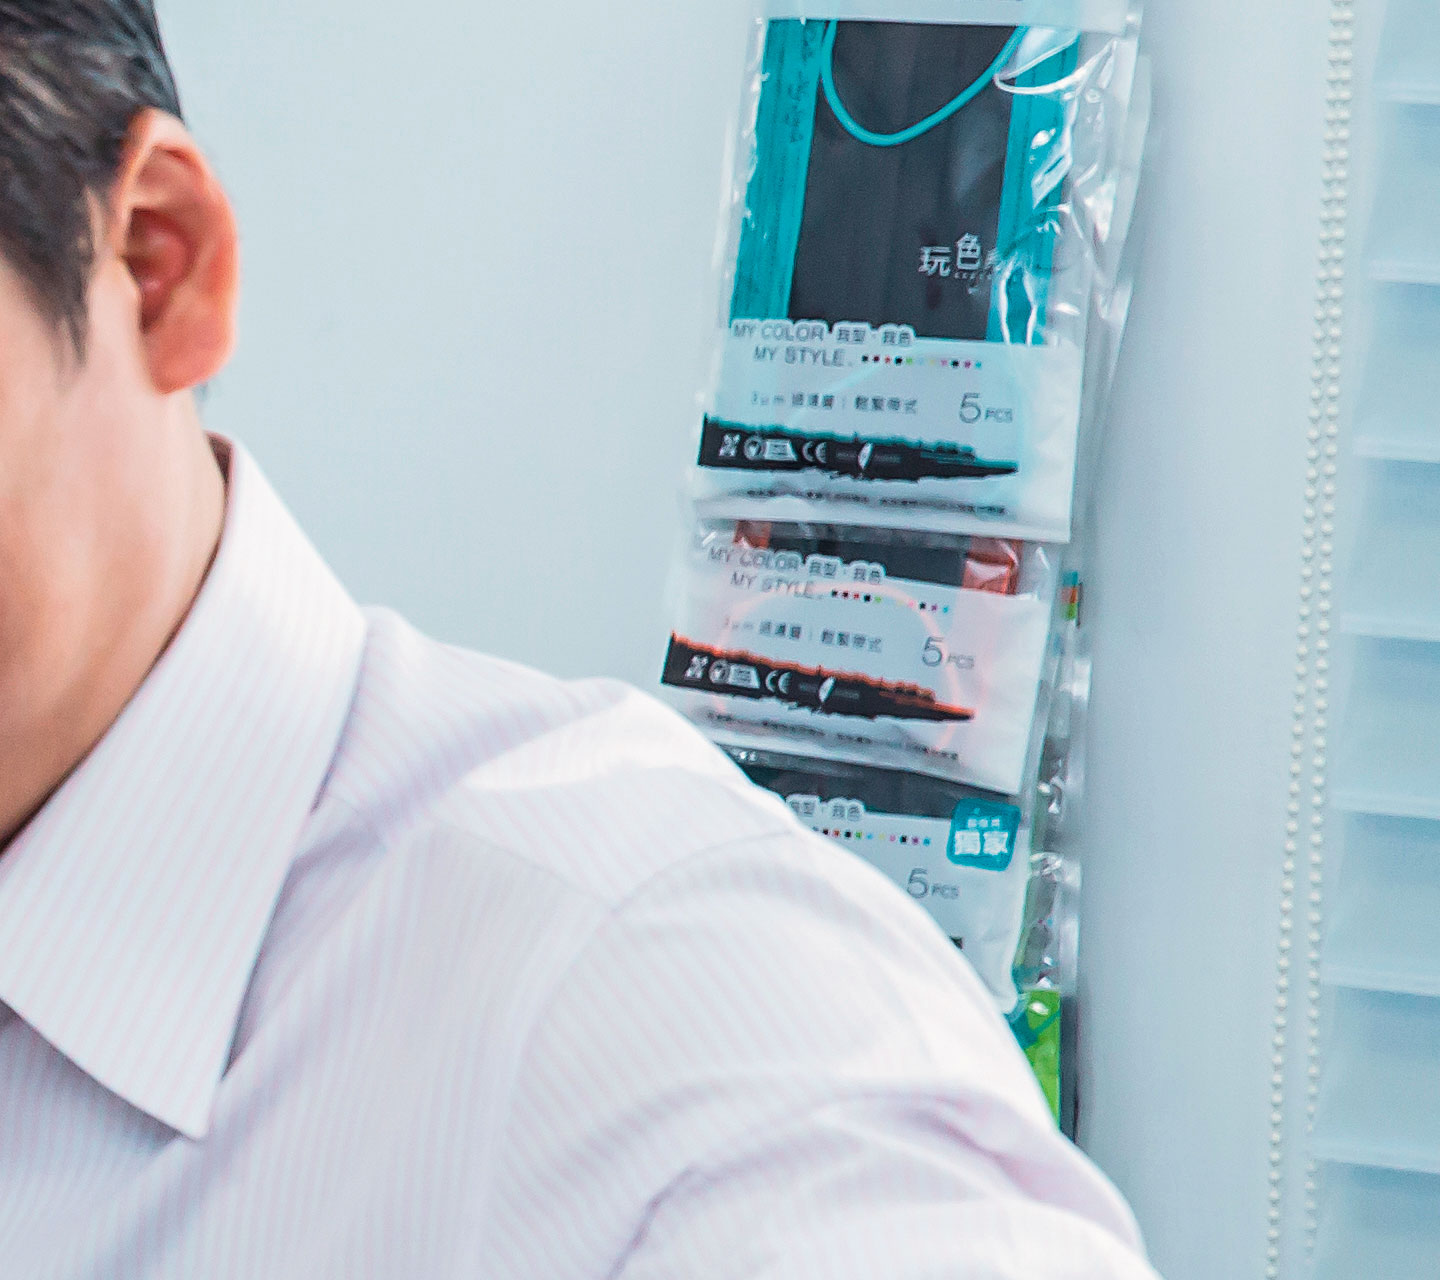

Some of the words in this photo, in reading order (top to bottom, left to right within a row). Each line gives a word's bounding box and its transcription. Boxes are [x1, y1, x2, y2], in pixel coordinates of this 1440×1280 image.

[733, 323, 754, 338] MY
[760, 323, 825, 342] COLOR
[753, 345, 778, 362] MY
[784, 347, 846, 368] STYLE
[959, 392, 982, 424] 5
[921, 636, 945, 667] 5
[906, 867, 929, 900] 5
